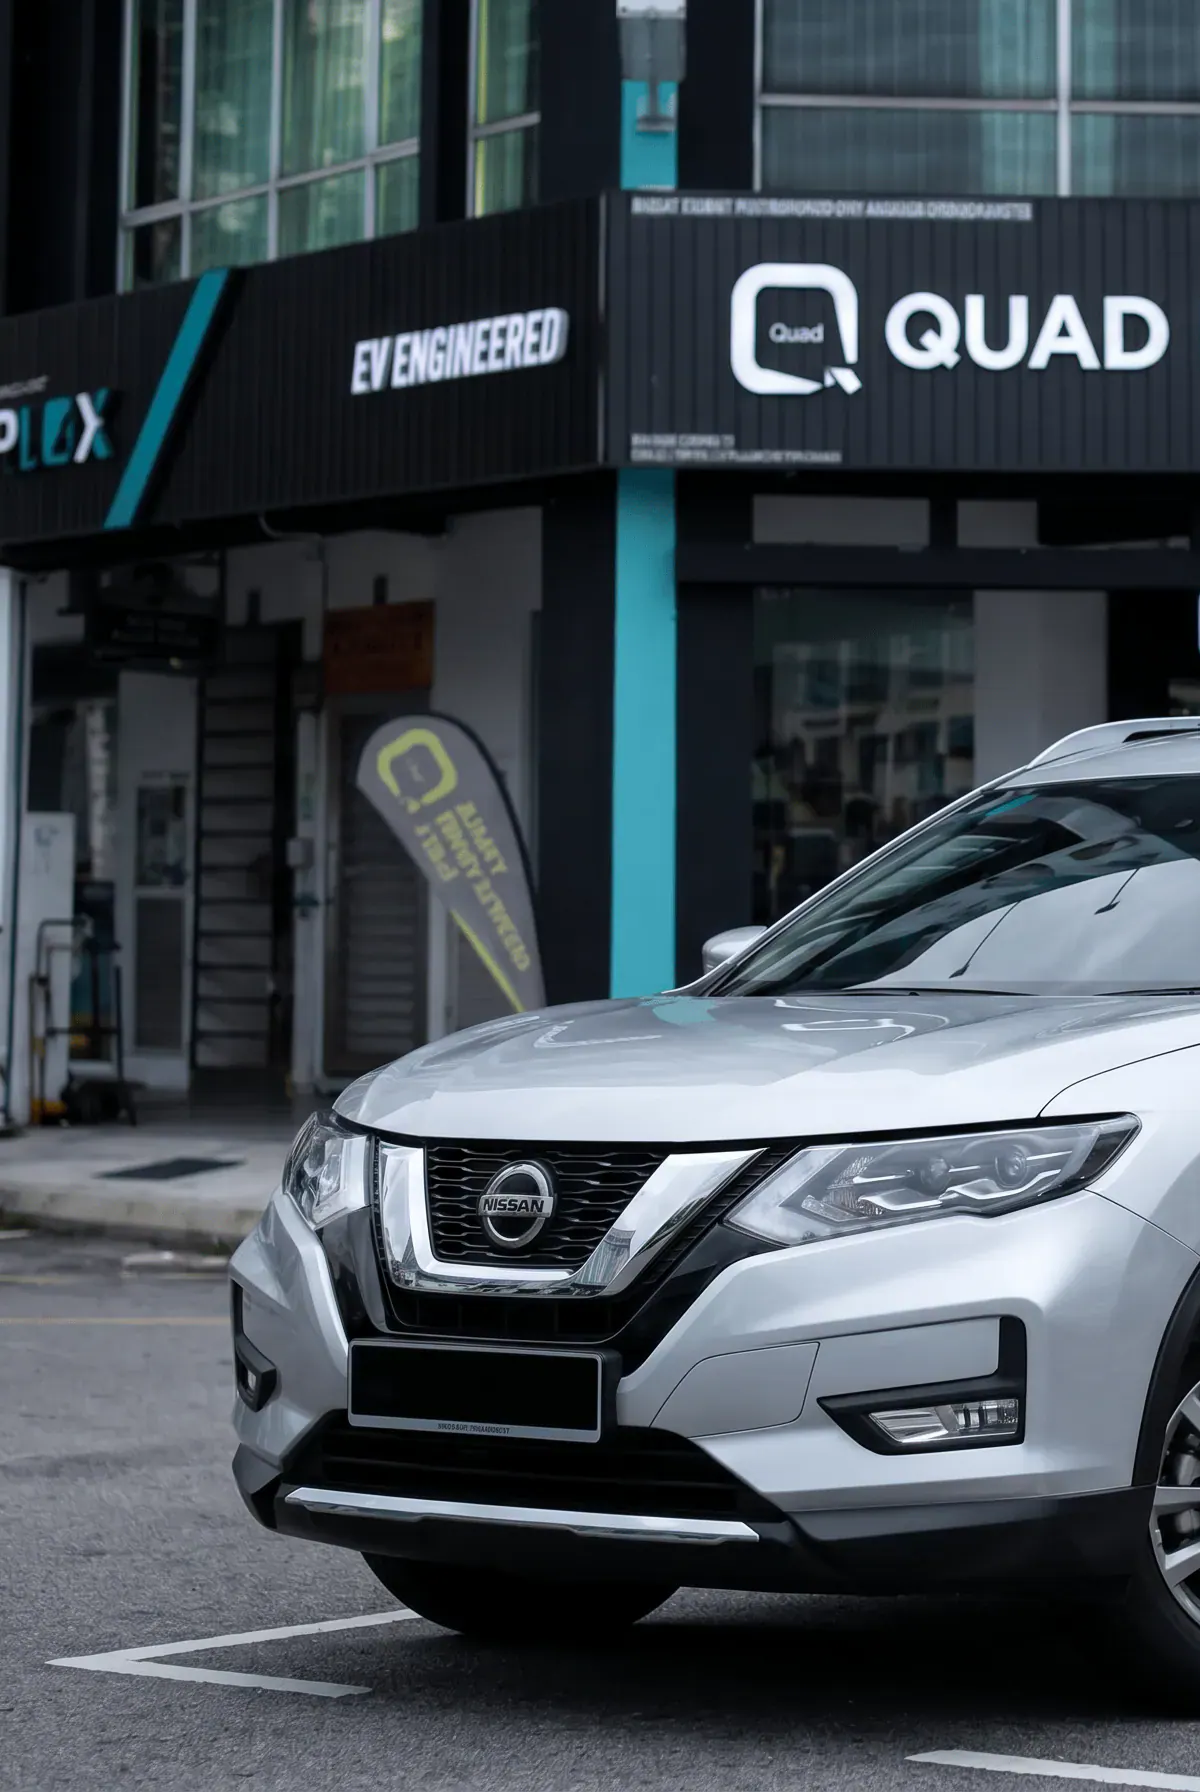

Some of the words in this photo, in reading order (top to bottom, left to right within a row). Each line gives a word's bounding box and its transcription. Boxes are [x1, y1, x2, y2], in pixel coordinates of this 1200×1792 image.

[351, 336, 392, 396] EV
[391, 307, 569, 389] ENGINEERED
[769, 322, 824, 344] Quad
[885, 292, 1170, 370] QUAD
[483, 1198, 544, 1213] NISSAN
